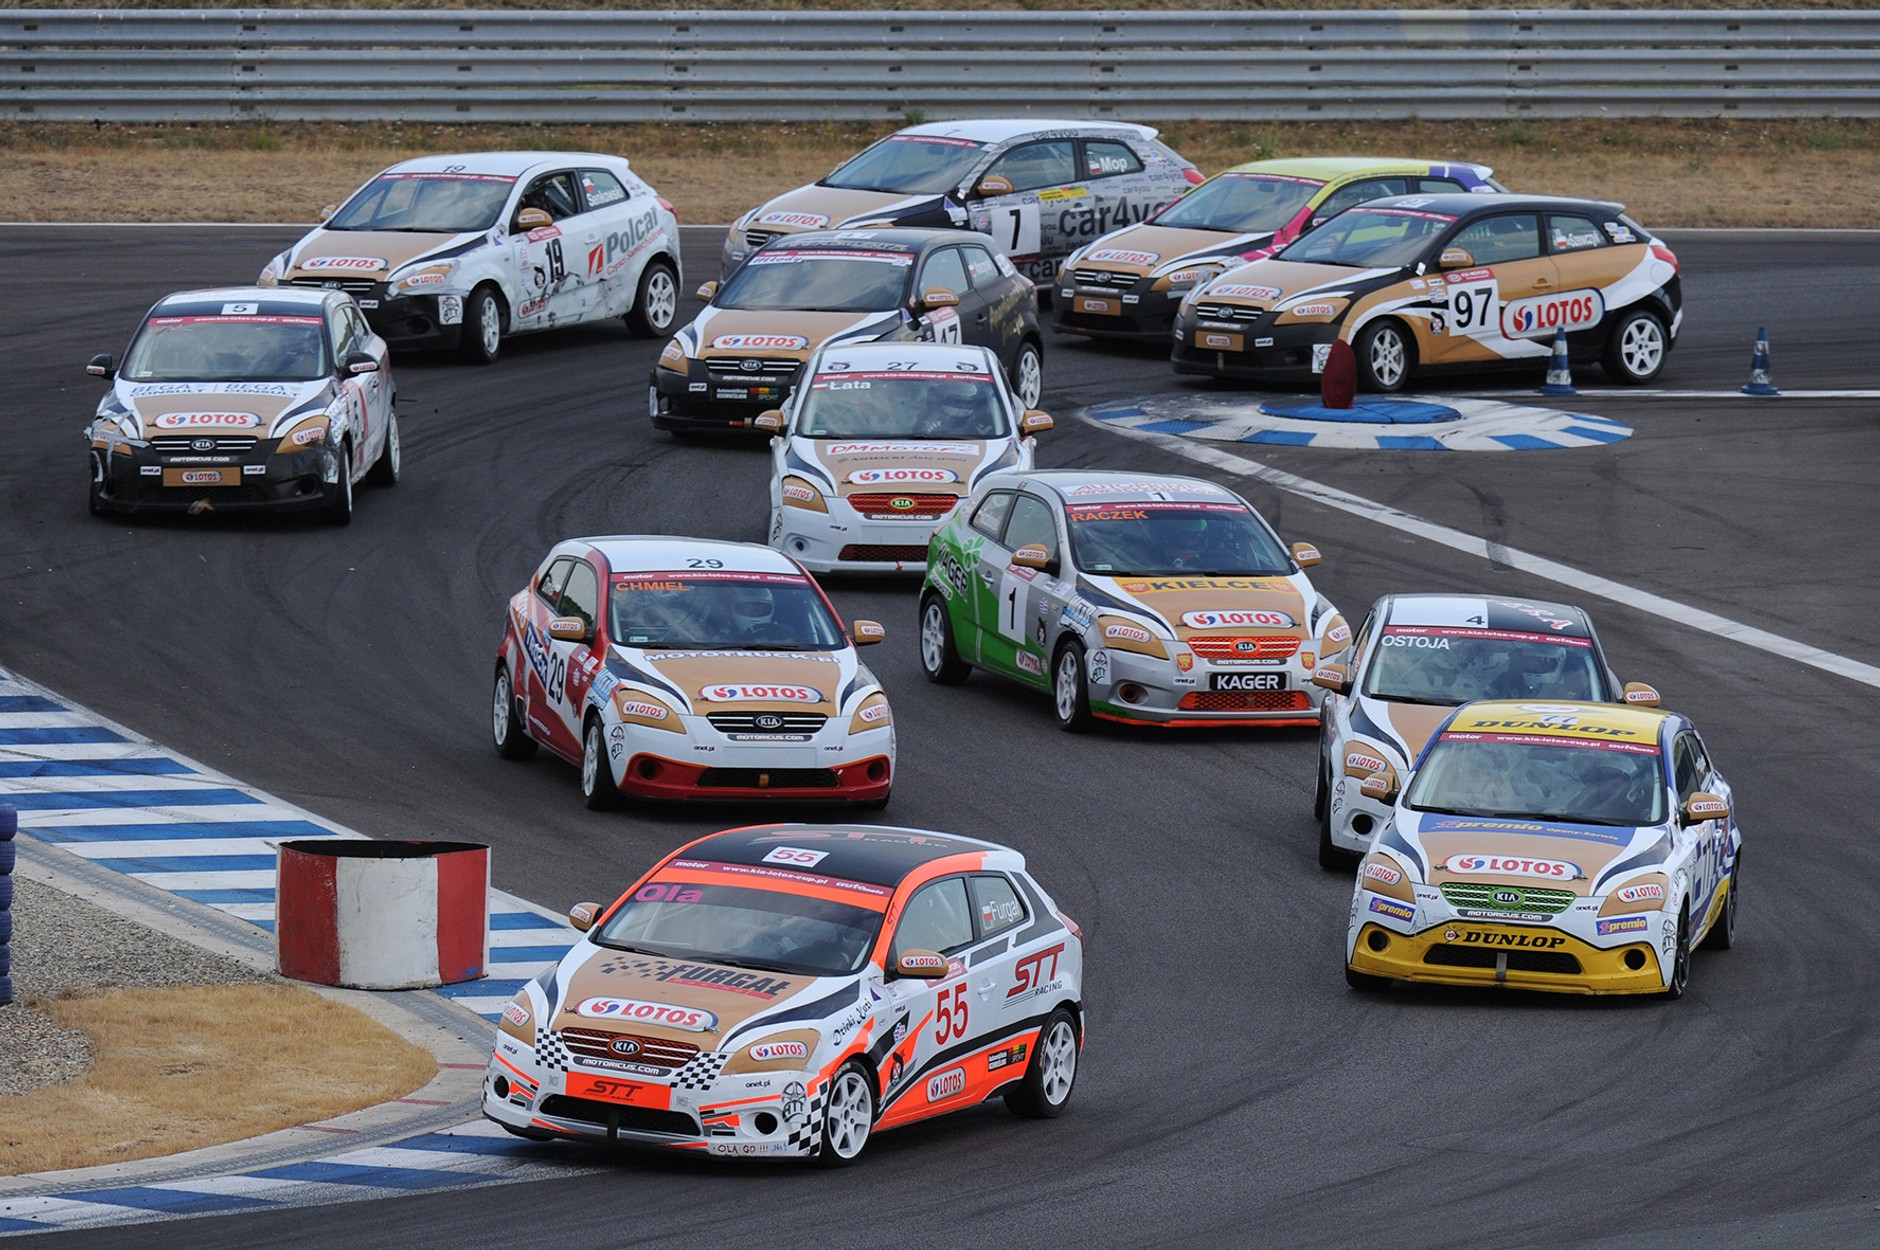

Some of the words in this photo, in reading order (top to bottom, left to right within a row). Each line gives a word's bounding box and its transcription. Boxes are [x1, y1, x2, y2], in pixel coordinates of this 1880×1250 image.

[442, 165, 467, 173] 19
[1100, 156, 1128, 172] Mop
[779, 215, 820, 226] LOTOS
[606, 205, 658, 265] Polcar
[1009, 208, 1021, 251] 7
[327, 258, 380, 269] LOTOS
[545, 238, 565, 284] 19
[1110, 252, 1152, 263] LOTOS
[419, 275, 443, 284] LOTOS
[1229, 287, 1272, 298] LOTOS
[232, 304, 248, 313] 5
[1306, 305, 1330, 314] LOTOS
[1454, 287, 1493, 329] 97
[1536, 296, 1593, 329] LOTOS
[743, 336, 798, 347] LOTOS
[887, 361, 919, 371] 27
[131, 384, 191, 394] BEGA
[225, 383, 287, 392] BEGA
[829, 380, 872, 391] Łata
[188, 413, 249, 425] LOTOS
[303, 427, 325, 441] LOTOS
[194, 473, 217, 481] LOTOS
[884, 470, 945, 481] LOTOS
[790, 487, 811, 500] LOTOS
[893, 499, 912, 507] KIA
[1071, 510, 1149, 523] RACZEK
[1025, 550, 1045, 559] LOTOS
[686, 558, 724, 569] 29
[615, 581, 690, 592] CHMIEL
[1151, 579, 1271, 592] KIELCE
[1009, 588, 1017, 630] 1
[1217, 612, 1282, 625] LOTOS
[1465, 615, 1485, 625] 4
[1117, 627, 1145, 640] LOTOS
[1441, 629, 1539, 641] www.kia-lotos-cup.pl
[1237, 642, 1255, 650] KIA
[1381, 635, 1450, 650] OSTOJA
[548, 652, 565, 705] 29
[1174, 677, 1195, 685] onet.pl
[1217, 673, 1279, 690] KAGER
[1324, 671, 1341, 681] LOTOS
[741, 687, 809, 699] LOTOS
[1636, 691, 1655, 699] LOTOS
[634, 703, 663, 717] LOTOS
[759, 717, 778, 726] KIA
[1469, 720, 1637, 737] DUNLOP
[1496, 735, 1601, 747] www.kia-lotos-cup.pl
[1355, 755, 1382, 770] LOTOS
[1368, 778, 1385, 789] LOTOS
[1702, 802, 1723, 810] LOTOS
[1454, 820, 1544, 831] premio
[1547, 827, 1619, 841] Opony-Serwis
[770, 849, 819, 863] 55
[675, 860, 709, 869] motor
[722, 866, 829, 885] www.kia-lotos-cup.pl
[1372, 866, 1397, 882] LOTOS
[1489, 858, 1565, 877] LOTOS
[635, 884, 704, 904] Ola
[1416, 892, 1439, 901] onet.pl
[1496, 891, 1520, 902] KIA
[1635, 885, 1661, 898] LOTOS
[1377, 900, 1413, 919] premio
[1467, 910, 1542, 921] MOTORICUS.COM
[1609, 918, 1647, 932] premio
[1463, 931, 1566, 949] DUNLOP
[915, 957, 939, 966] LOTOS
[1005, 942, 1065, 999] STT
[1033, 980, 1063, 996] RACING
[506, 1003, 527, 1025] LOTOS
[619, 1005, 702, 1027] LOTOS
[935, 982, 968, 1046] 55
[614, 1043, 637, 1053] KIA
[770, 1044, 804, 1057] LOTOS
[581, 1057, 660, 1075] MOTORICUS.COM
[585, 1079, 644, 1098] STT
[745, 1079, 771, 1089] onet.pl
[938, 1072, 962, 1095] LOTOS
[717, 1144, 739, 1154] OLA
[742, 1144, 757, 1154] GO
